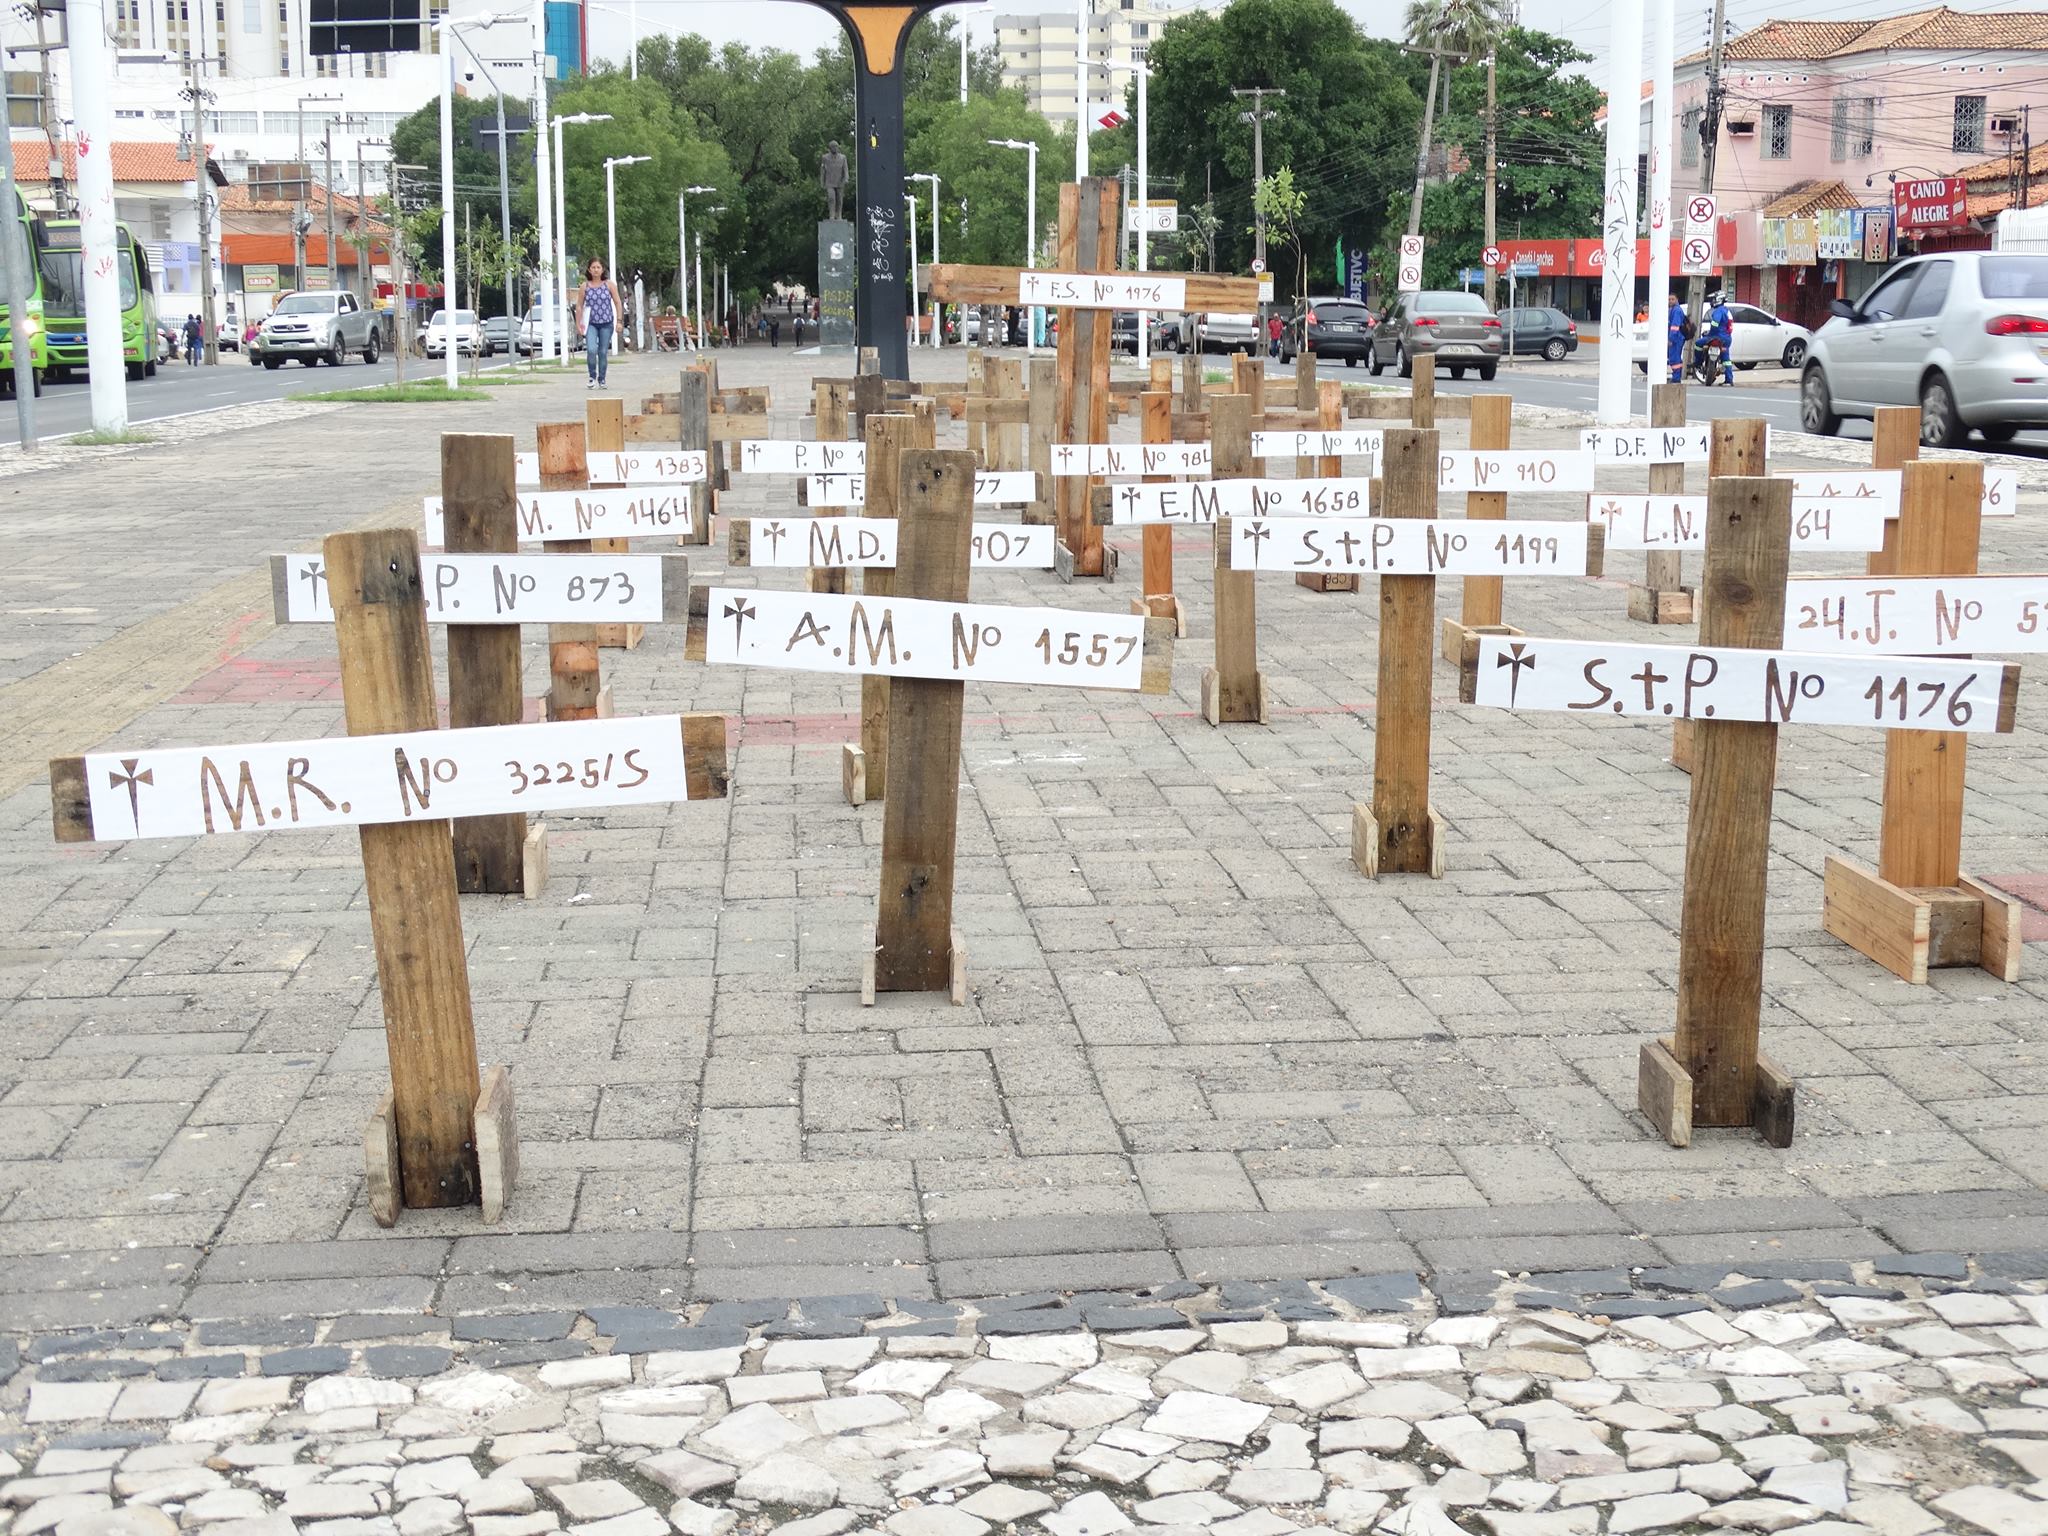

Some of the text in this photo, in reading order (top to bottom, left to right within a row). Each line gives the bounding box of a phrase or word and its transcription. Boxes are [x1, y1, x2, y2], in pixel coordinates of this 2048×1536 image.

[1909, 180, 1946, 200] CANTO
[1911, 204, 1949, 223] ALEGRE
[1792, 223, 1806, 240] BAR
[1052, 282, 1079, 299] F.S.
[1126, 285, 1160, 302] 1976
[796, 445, 807, 468] P.
[1295, 433, 1308, 456] P.
[1616, 437, 1646, 457] D.F.
[655, 456, 704, 476] 1383
[1088, 446, 1126, 475] L.N.
[1440, 455, 1455, 486] P.
[1517, 461, 1555, 483] 910
[851, 479, 864, 502] F.
[1159, 483, 1231, 523] E.M.
[1301, 486, 1360, 515] 1658
[626, 496, 689, 526] 1464
[1643, 501, 1698, 544] L.N.
[808, 520, 886, 567] M.D.
[1495, 534, 1557, 564] 1199
[567, 572, 634, 604] 873
[1798, 590, 1896, 644] 24.J.
[2016, 600, 2048, 634] 5
[784, 600, 914, 668] A.M.
[1033, 626, 1140, 668] 1557
[1863, 671, 1979, 728] 1176
[198, 754, 352, 835] M.R.
[505, 749, 648, 794] 3225/S
